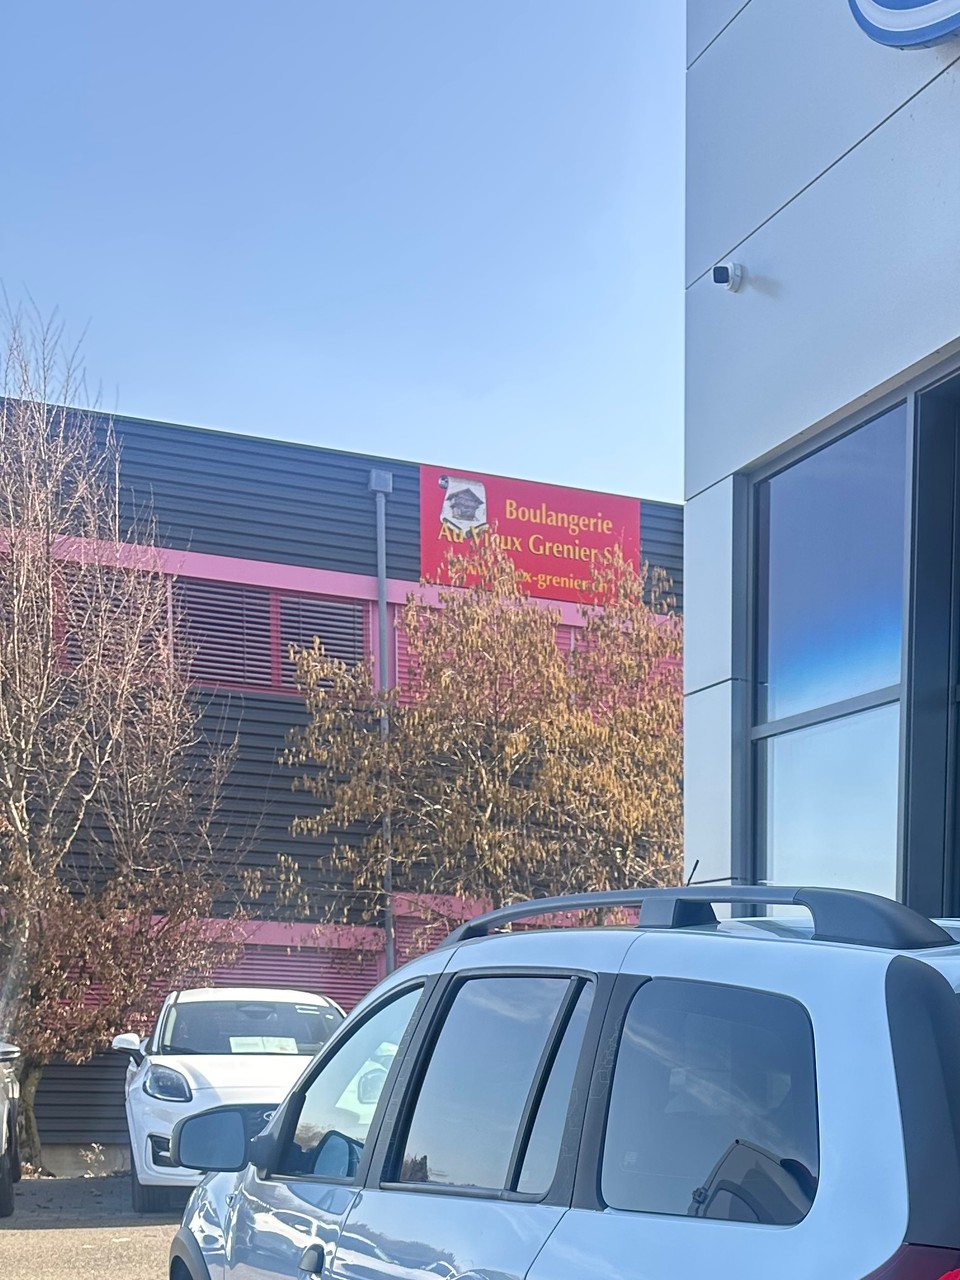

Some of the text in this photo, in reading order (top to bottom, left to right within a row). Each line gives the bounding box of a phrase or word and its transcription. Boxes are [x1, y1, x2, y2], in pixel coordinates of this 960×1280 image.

[505, 499, 613, 535] Boulangerie
[438, 522, 465, 543] Au
[471, 526, 522, 552] Viux
[528, 534, 598, 563] Grenier
